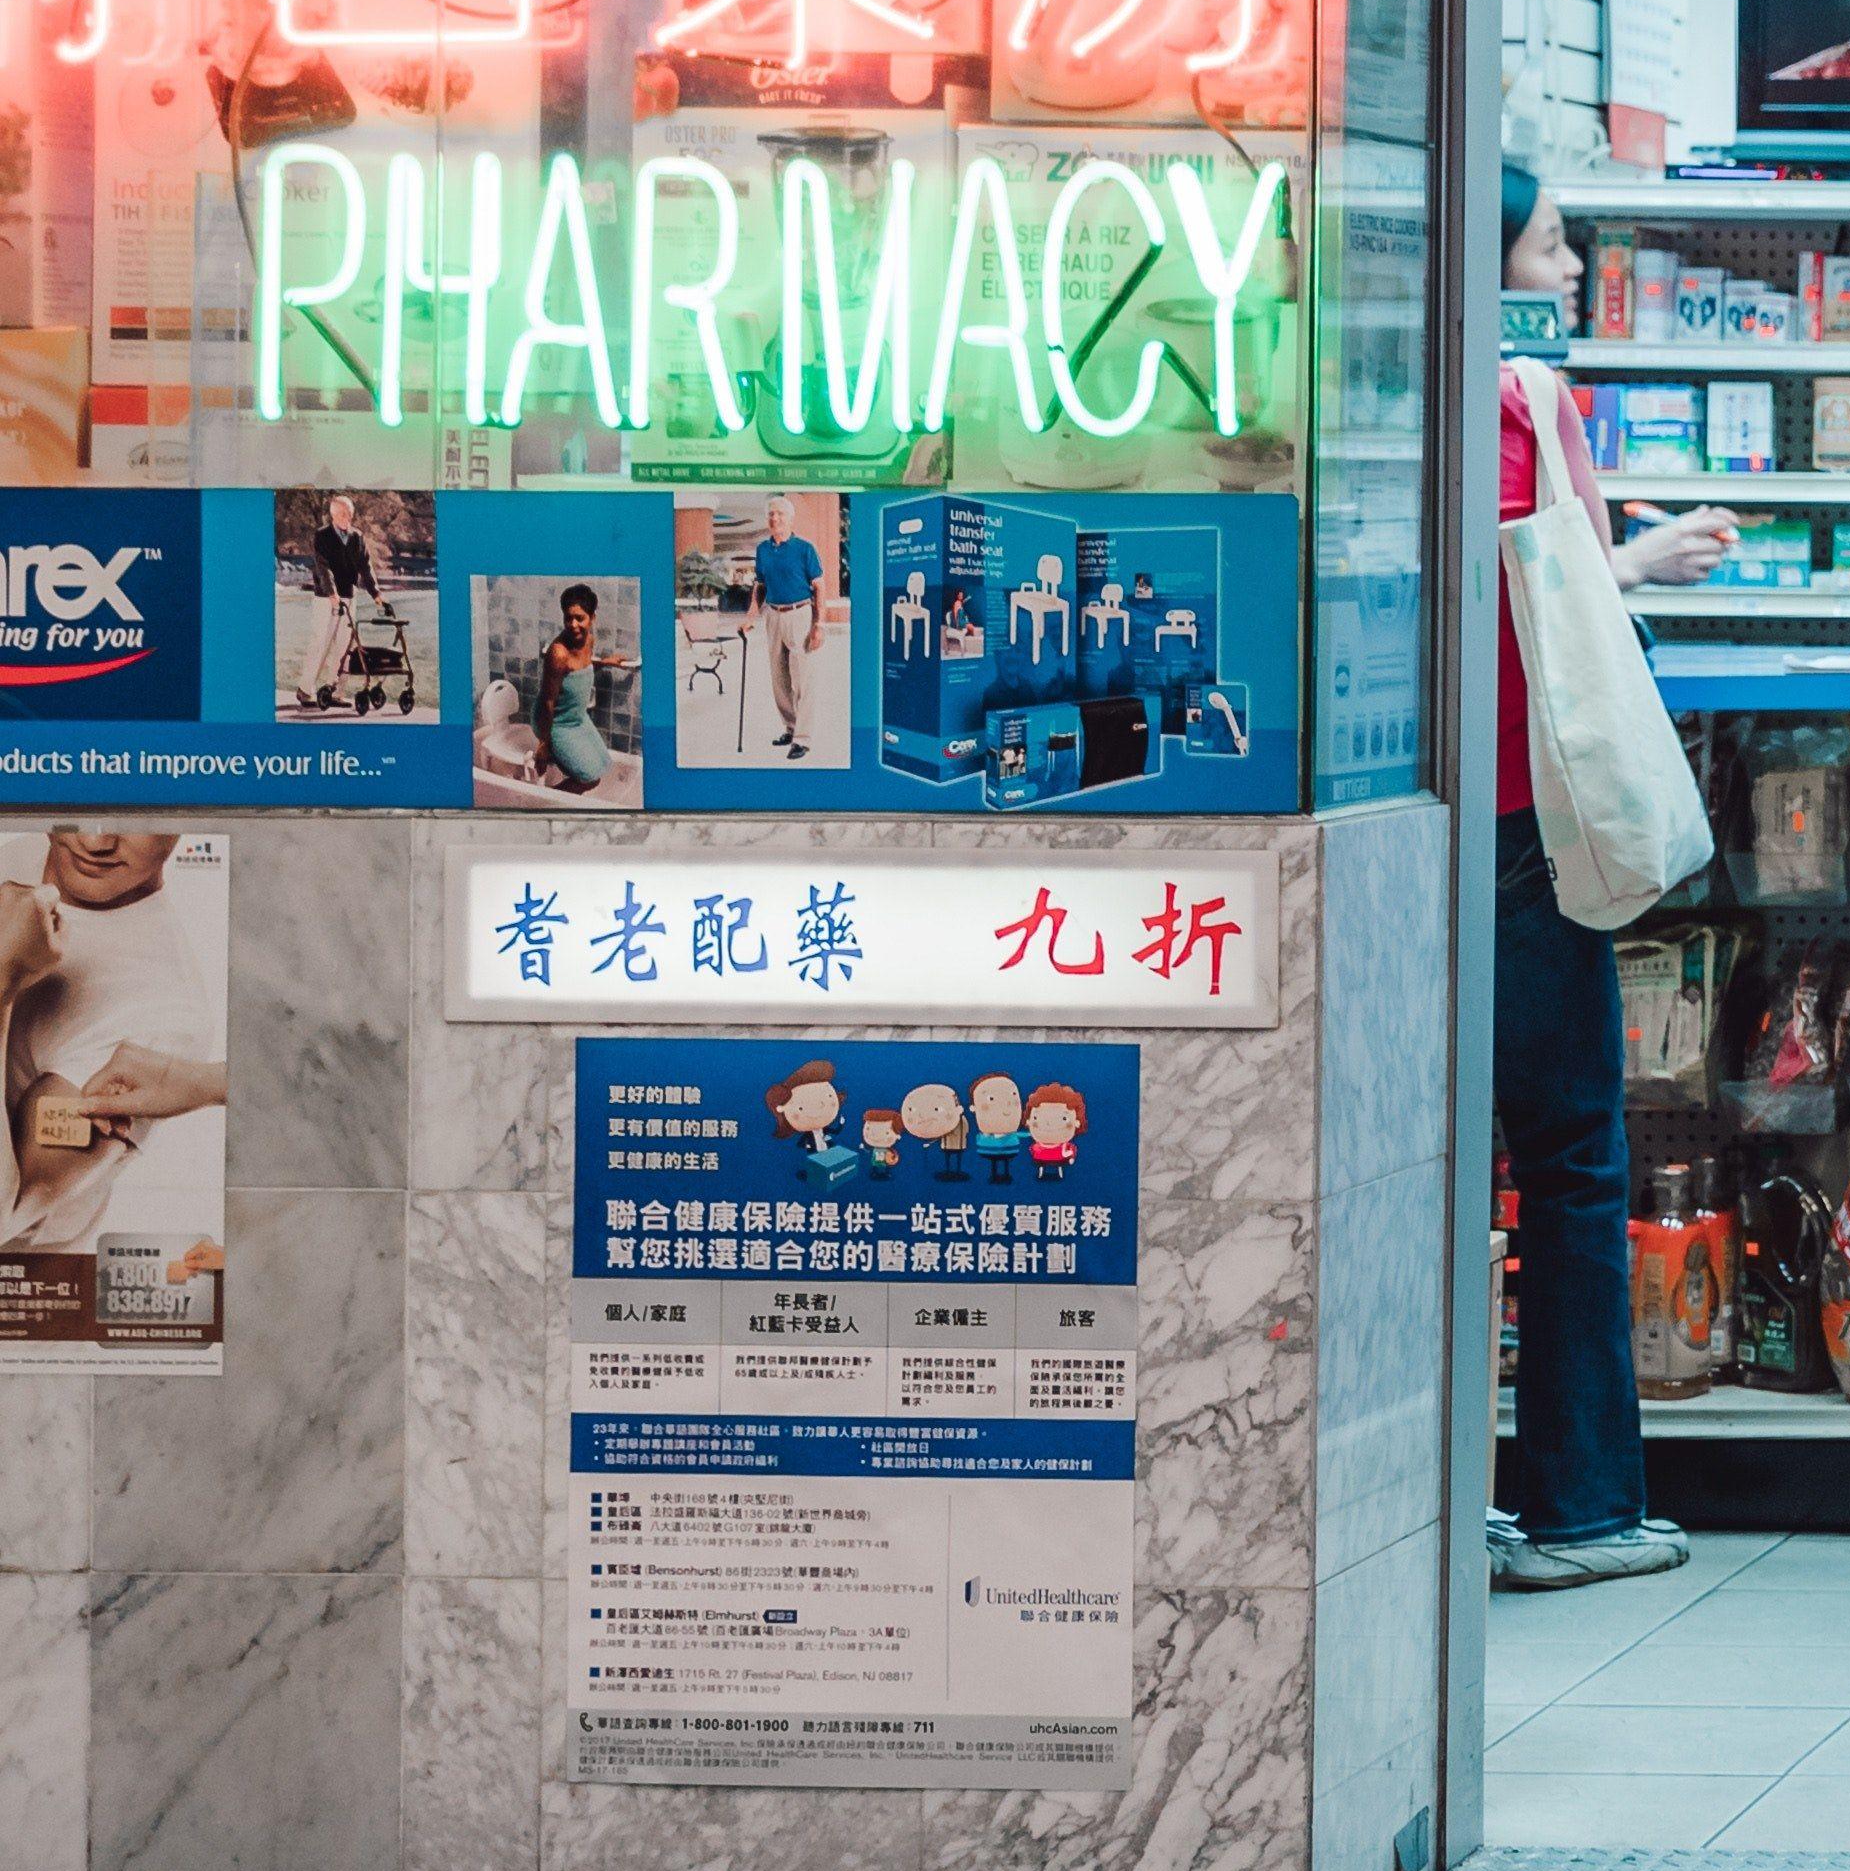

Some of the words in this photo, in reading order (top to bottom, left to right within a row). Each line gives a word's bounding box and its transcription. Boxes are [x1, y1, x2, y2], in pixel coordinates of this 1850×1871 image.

[664, 125, 707, 144] OSTER
[243, 178, 331, 200] Coker
[1099, 225, 1131, 247] RIZ
[1016, 248, 1114, 274] RÉHAUD
[258, 141, 1289, 438] PHARMACY
[981, 277, 1111, 302] ÉLCTIQUE
[949, 509, 1004, 529] universal
[949, 524, 996, 543] transfer
[949, 539, 976, 556] bath
[0, 544, 145, 622] rex
[46, 623, 87, 652] for
[93, 626, 144, 651] you
[80, 749, 131, 776] that
[138, 749, 246, 781] improve
[254, 752, 313, 781] your
[494, 879, 866, 993] 耆老配藥
[993, 881, 1244, 997] 九折
[607, 1084, 702, 1106] 更好的體驗
[607, 1117, 740, 1139] 更有價值的服務
[607, 1150, 720, 1172] 更健康的生活
[604, 1199, 1113, 1238] 聯合健康保險提供一站式優質服務
[605, 1236, 1077, 1275] 幫您挑選適合您的醫療保險計劃
[773, 1292, 838, 1312] 年長者/
[604, 1303, 688, 1324] 個人/家庭
[913, 1307, 989, 1328] 企業僱主
[1058, 1308, 1097, 1329] 旅客
[748, 1314, 860, 1336] 紅藍卡受益人
[985, 1587, 1121, 1607] UnitedHealthcare
[1020, 1609, 1120, 1624] 聯合健康保險
[682, 1717, 789, 1732] 1-800-801-1900
[913, 1720, 935, 1734] 711
[1029, 1722, 1118, 1735] uhcAsian.com
